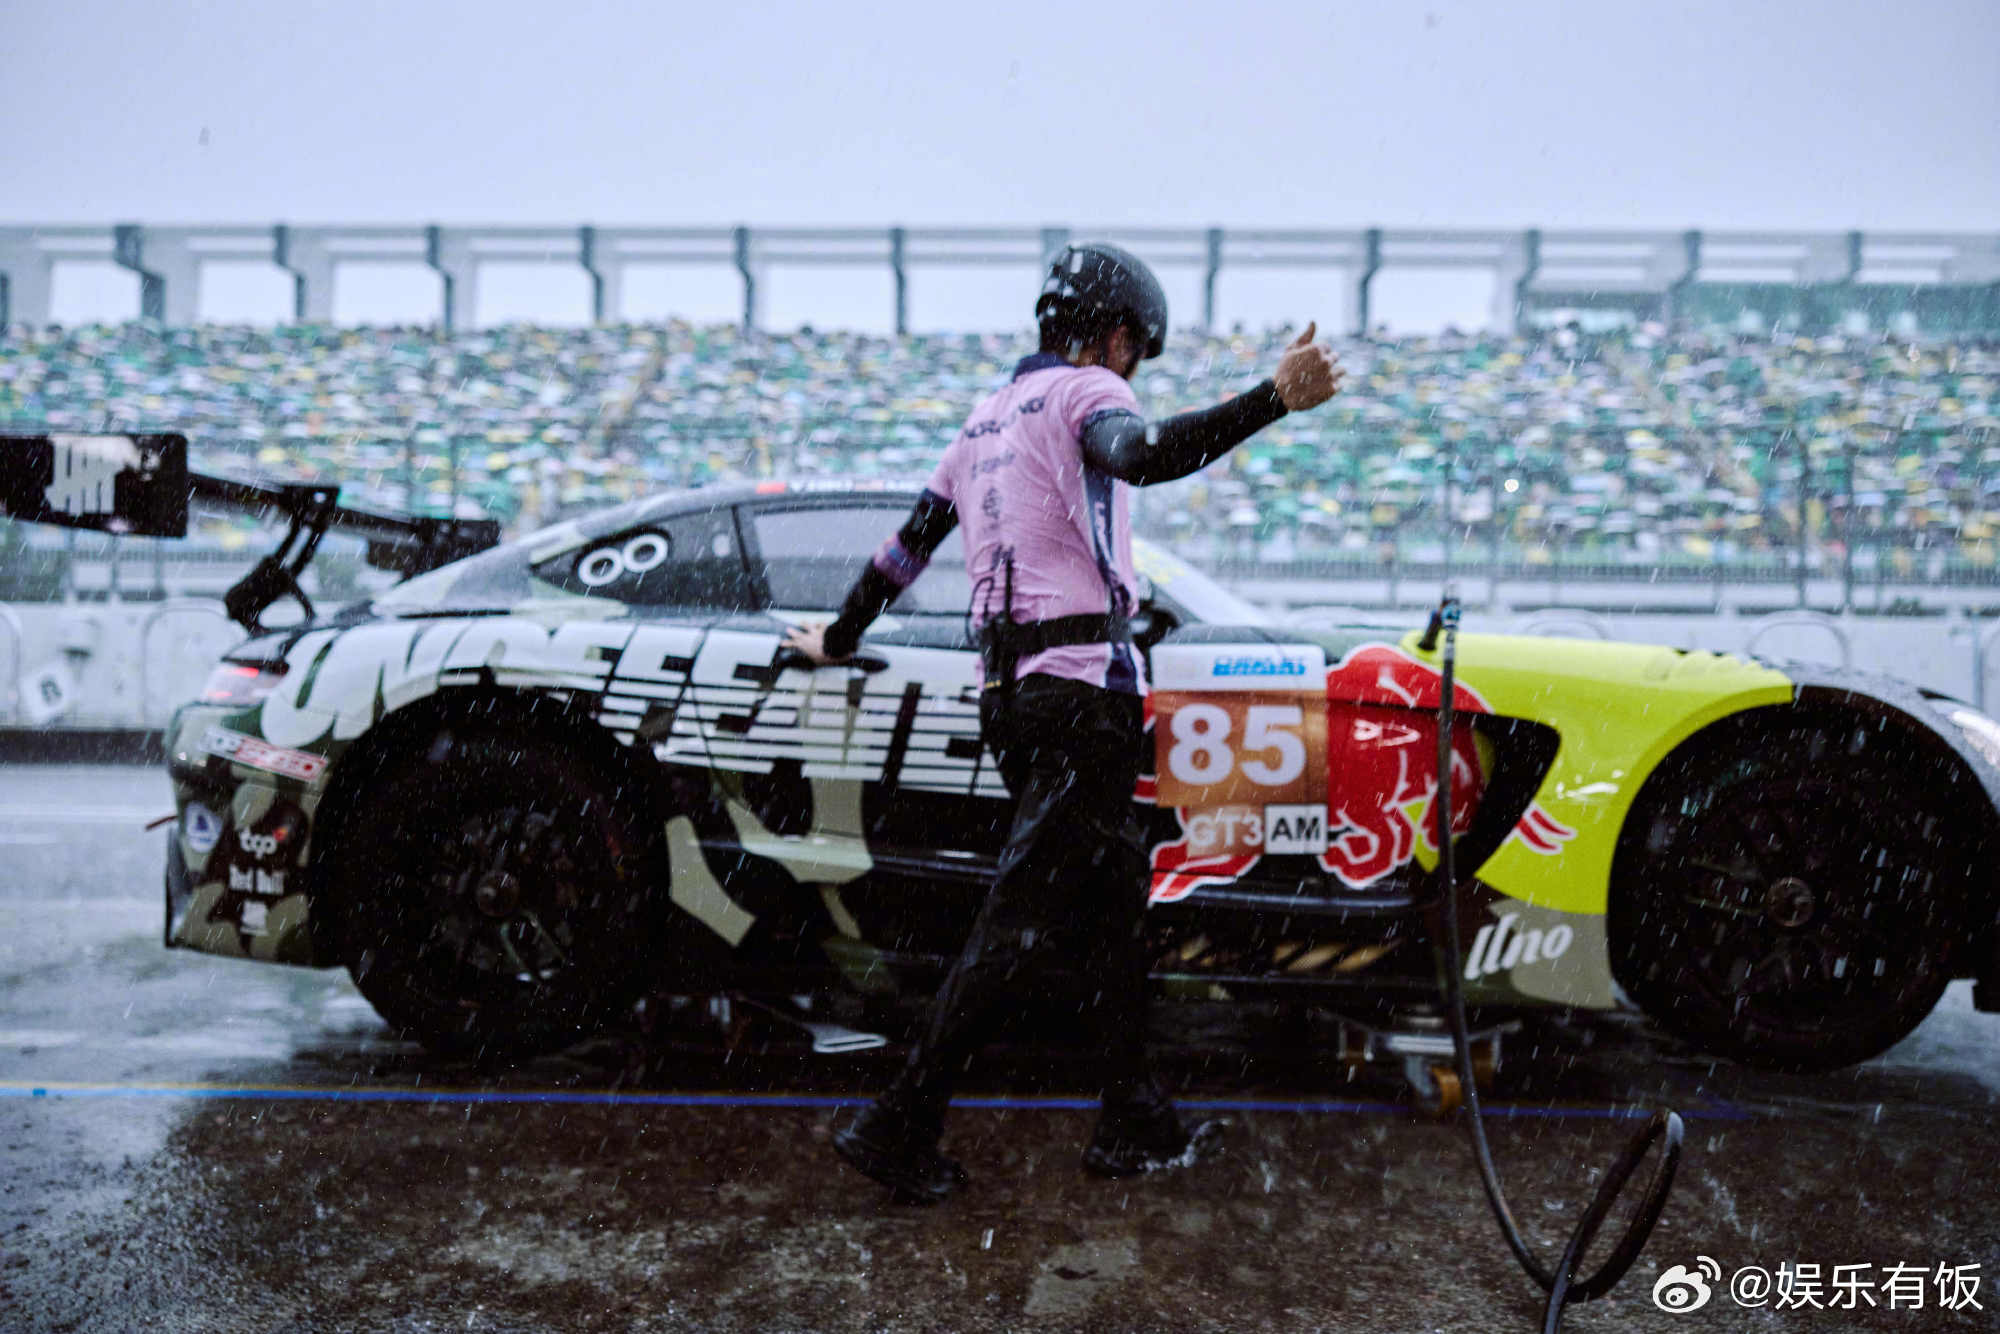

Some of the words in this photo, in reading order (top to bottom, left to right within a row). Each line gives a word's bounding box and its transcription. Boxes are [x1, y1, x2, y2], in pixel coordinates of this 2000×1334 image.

[1168, 703, 1306, 786] 85
[1187, 814, 1264, 847] GT3
[1271, 817, 1320, 841] AM
